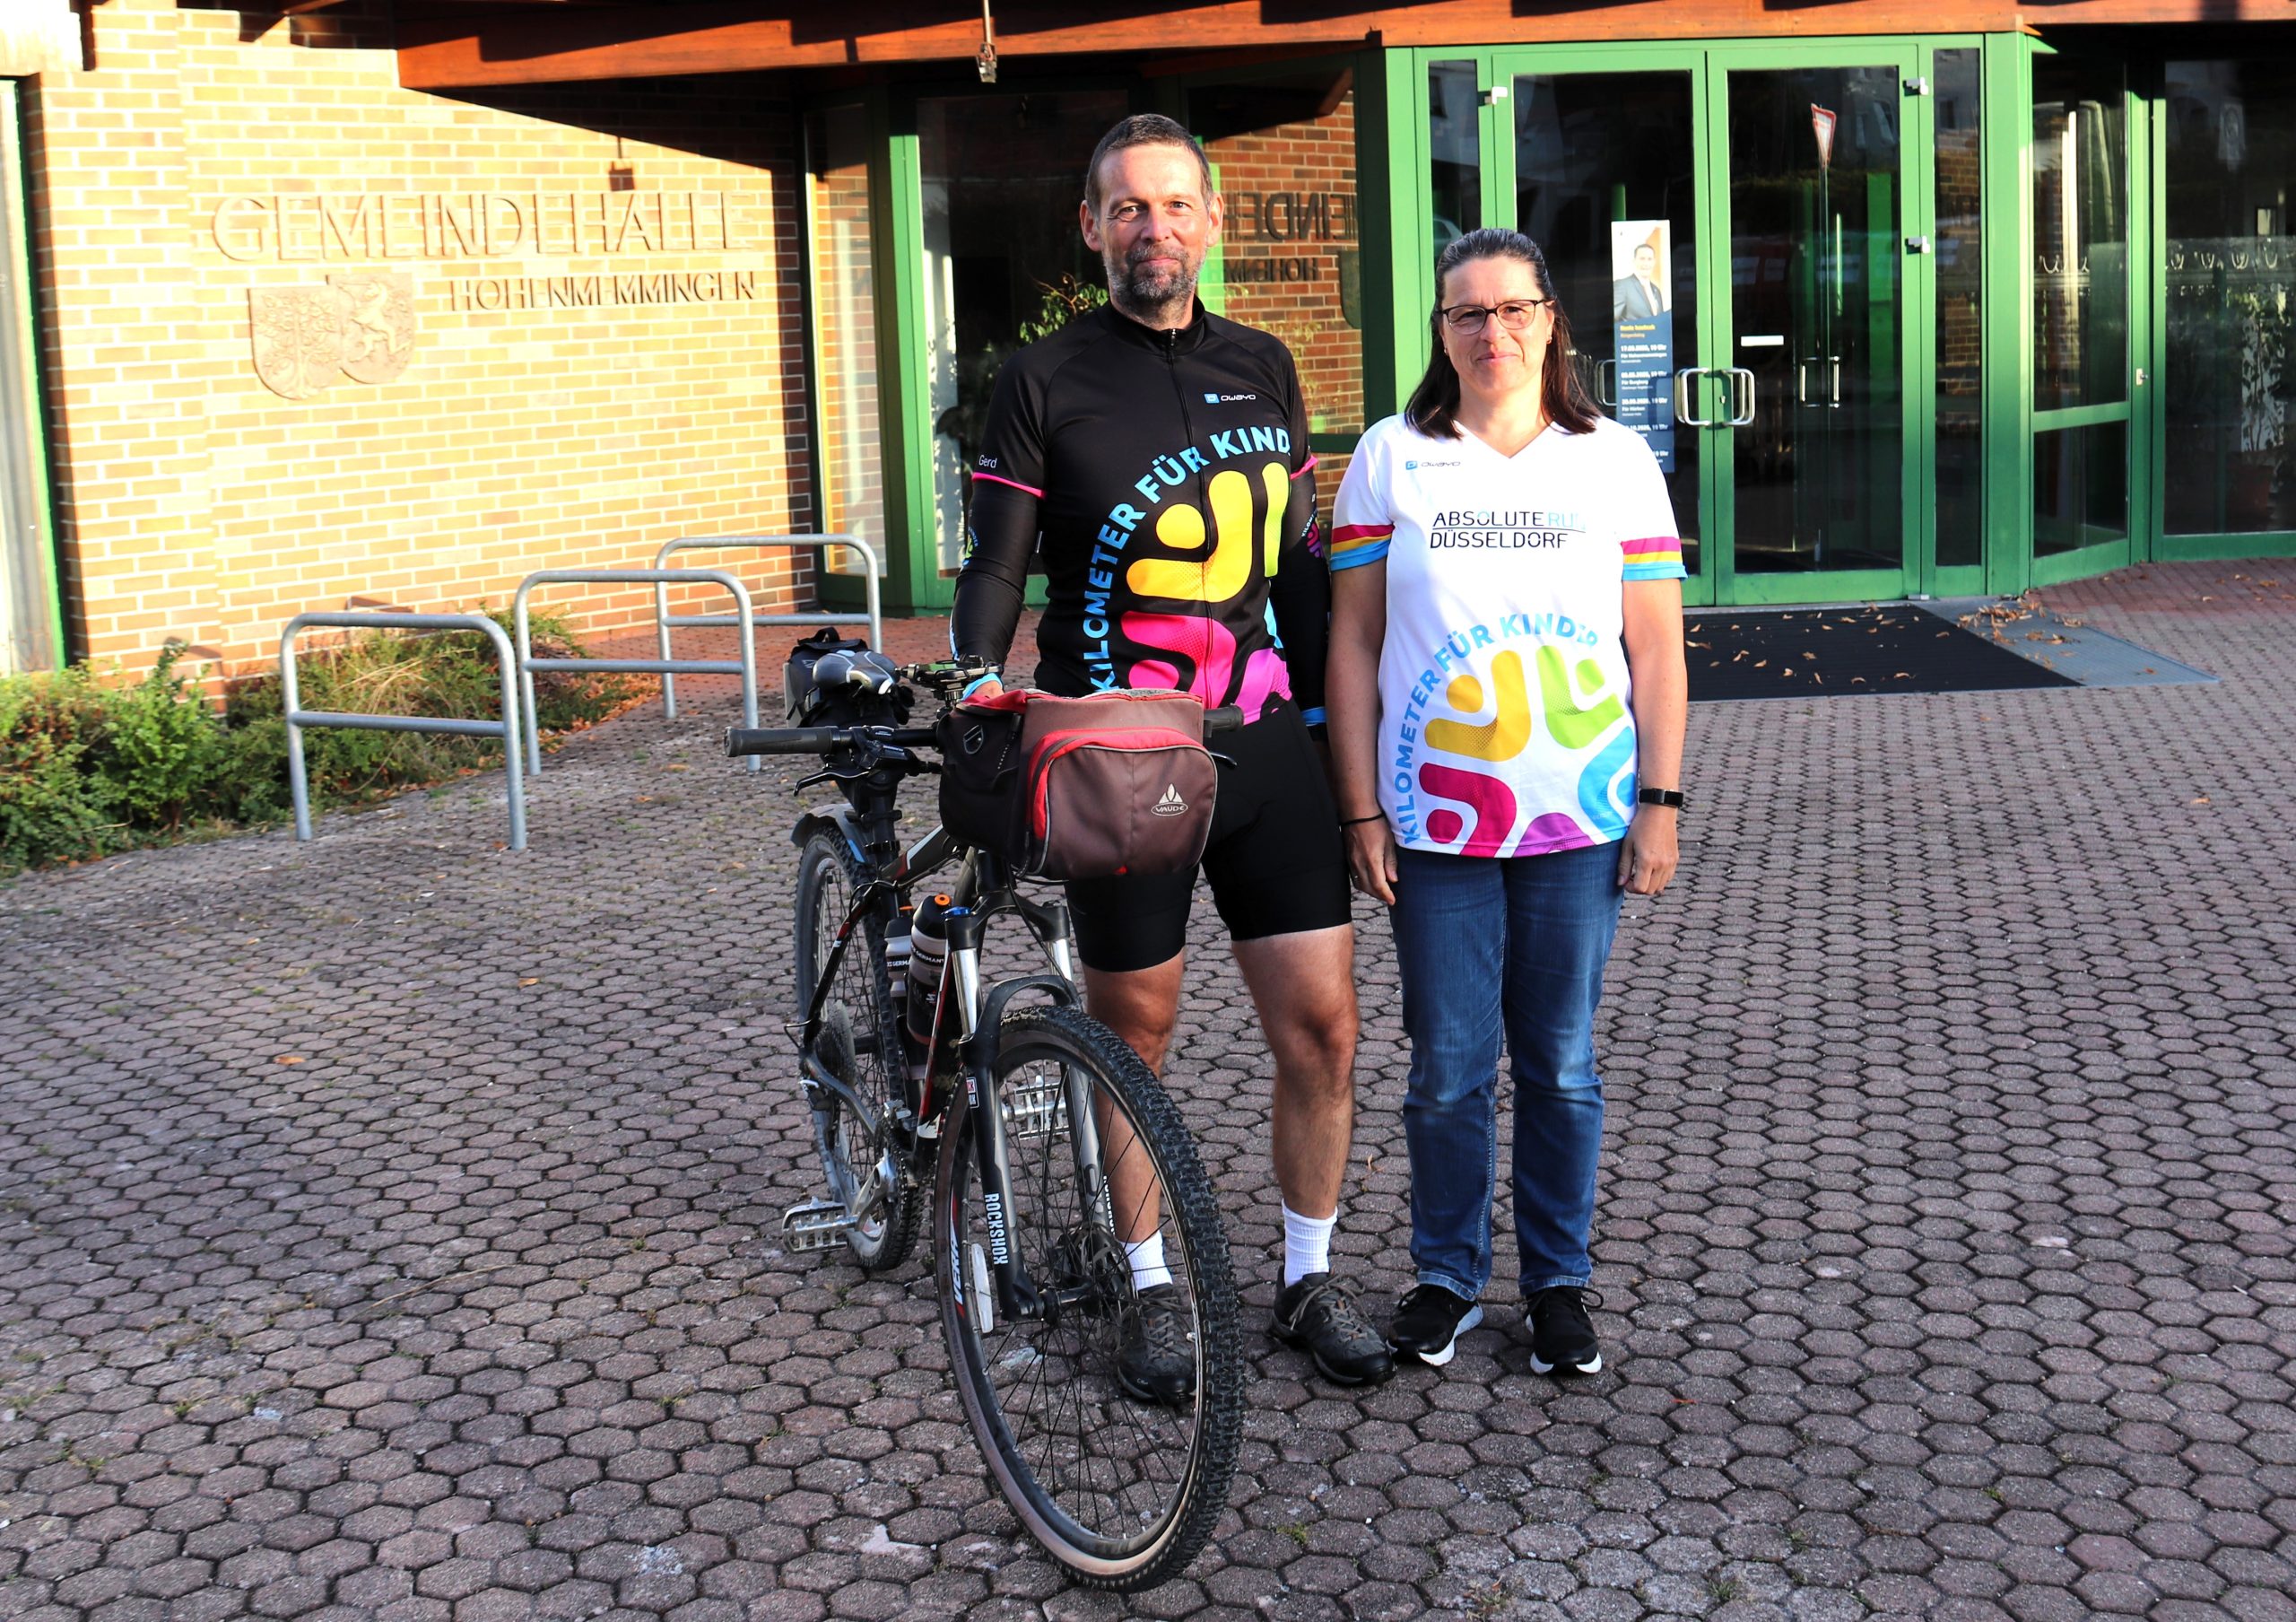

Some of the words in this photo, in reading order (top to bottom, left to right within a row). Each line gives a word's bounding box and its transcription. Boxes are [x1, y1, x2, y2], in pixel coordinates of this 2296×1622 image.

[211, 192, 754, 261] GEMEINDEHALLE
[450, 271, 755, 311] HOHENMEMMINGEN
[978, 454, 997, 468] Gerd
[1083, 502, 1147, 693] KILOMETER
[1134, 446, 1211, 504] FÜR
[1209, 426, 1291, 459] KIND
[1430, 529, 1569, 549] DÜSSELDORF
[1394, 668, 1442, 845] KILOMETER
[1433, 624, 1495, 673] FÜR
[1155, 805, 1185, 813] VAUDE
[984, 1192, 1009, 1265] ROCKSHOX
